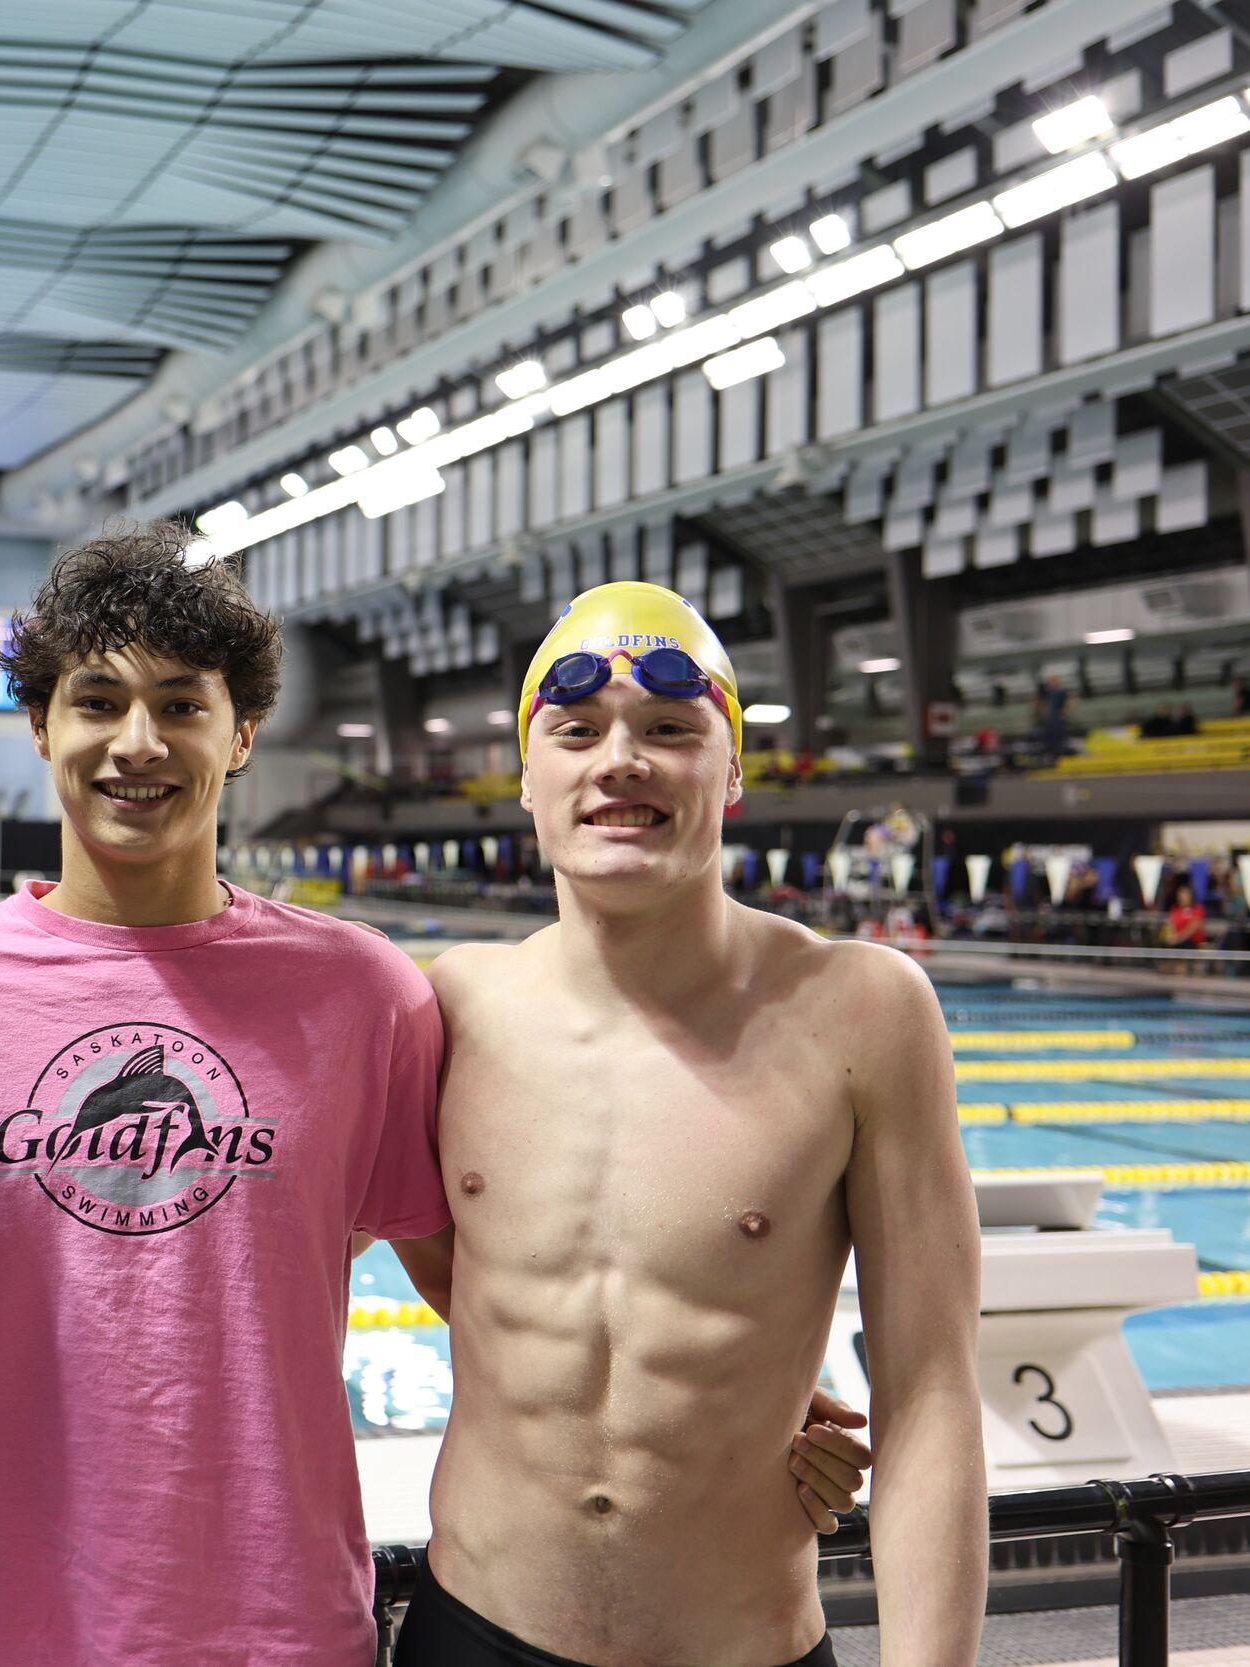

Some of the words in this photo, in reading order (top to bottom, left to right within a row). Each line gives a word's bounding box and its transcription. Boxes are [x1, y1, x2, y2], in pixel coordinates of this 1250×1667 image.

[580, 633, 681, 650] GLDFINS
[56, 1032, 221, 1082] SASKATOON
[62, 1184, 210, 1227] SWIMMING
[1013, 1364, 1073, 1441] 3
